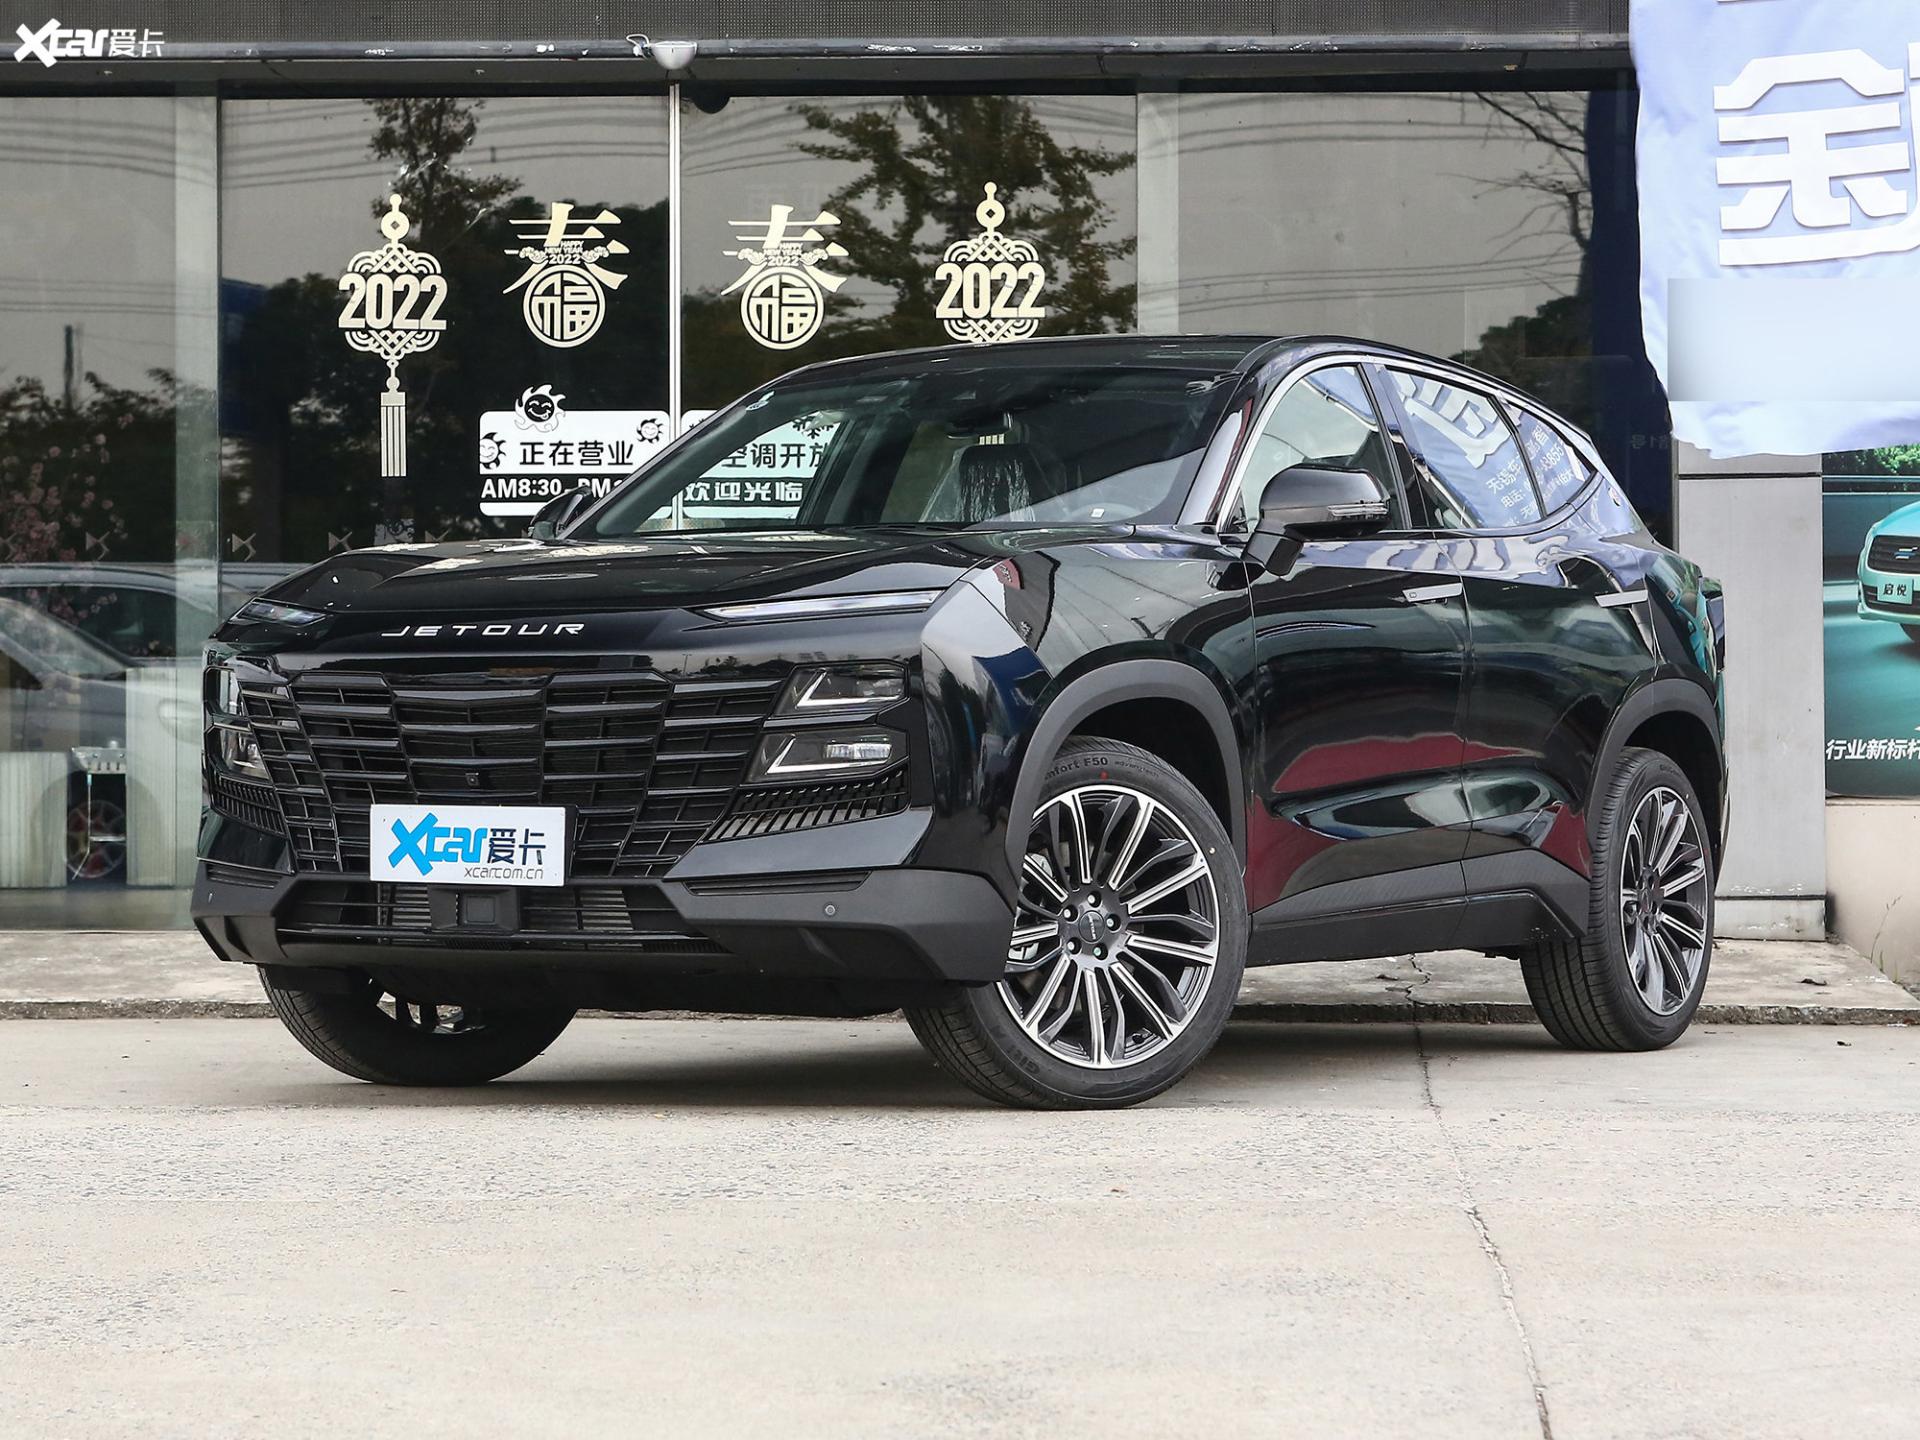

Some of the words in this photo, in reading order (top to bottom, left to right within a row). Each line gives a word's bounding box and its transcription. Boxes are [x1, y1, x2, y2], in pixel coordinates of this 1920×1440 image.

[548, 253, 581, 265] 2022
[767, 256, 799, 266] 2022
[338, 272, 448, 330] 2022
[935, 262, 1046, 319] 2022
[530, 272, 598, 340] 福
[748, 274, 817, 342] 福
[519, 440, 633, 466] 正在营业
[684, 482, 803, 502] 欢迎光临
[381, 623, 585, 637] JETOUR
[1084, 756, 1108, 767] F50
